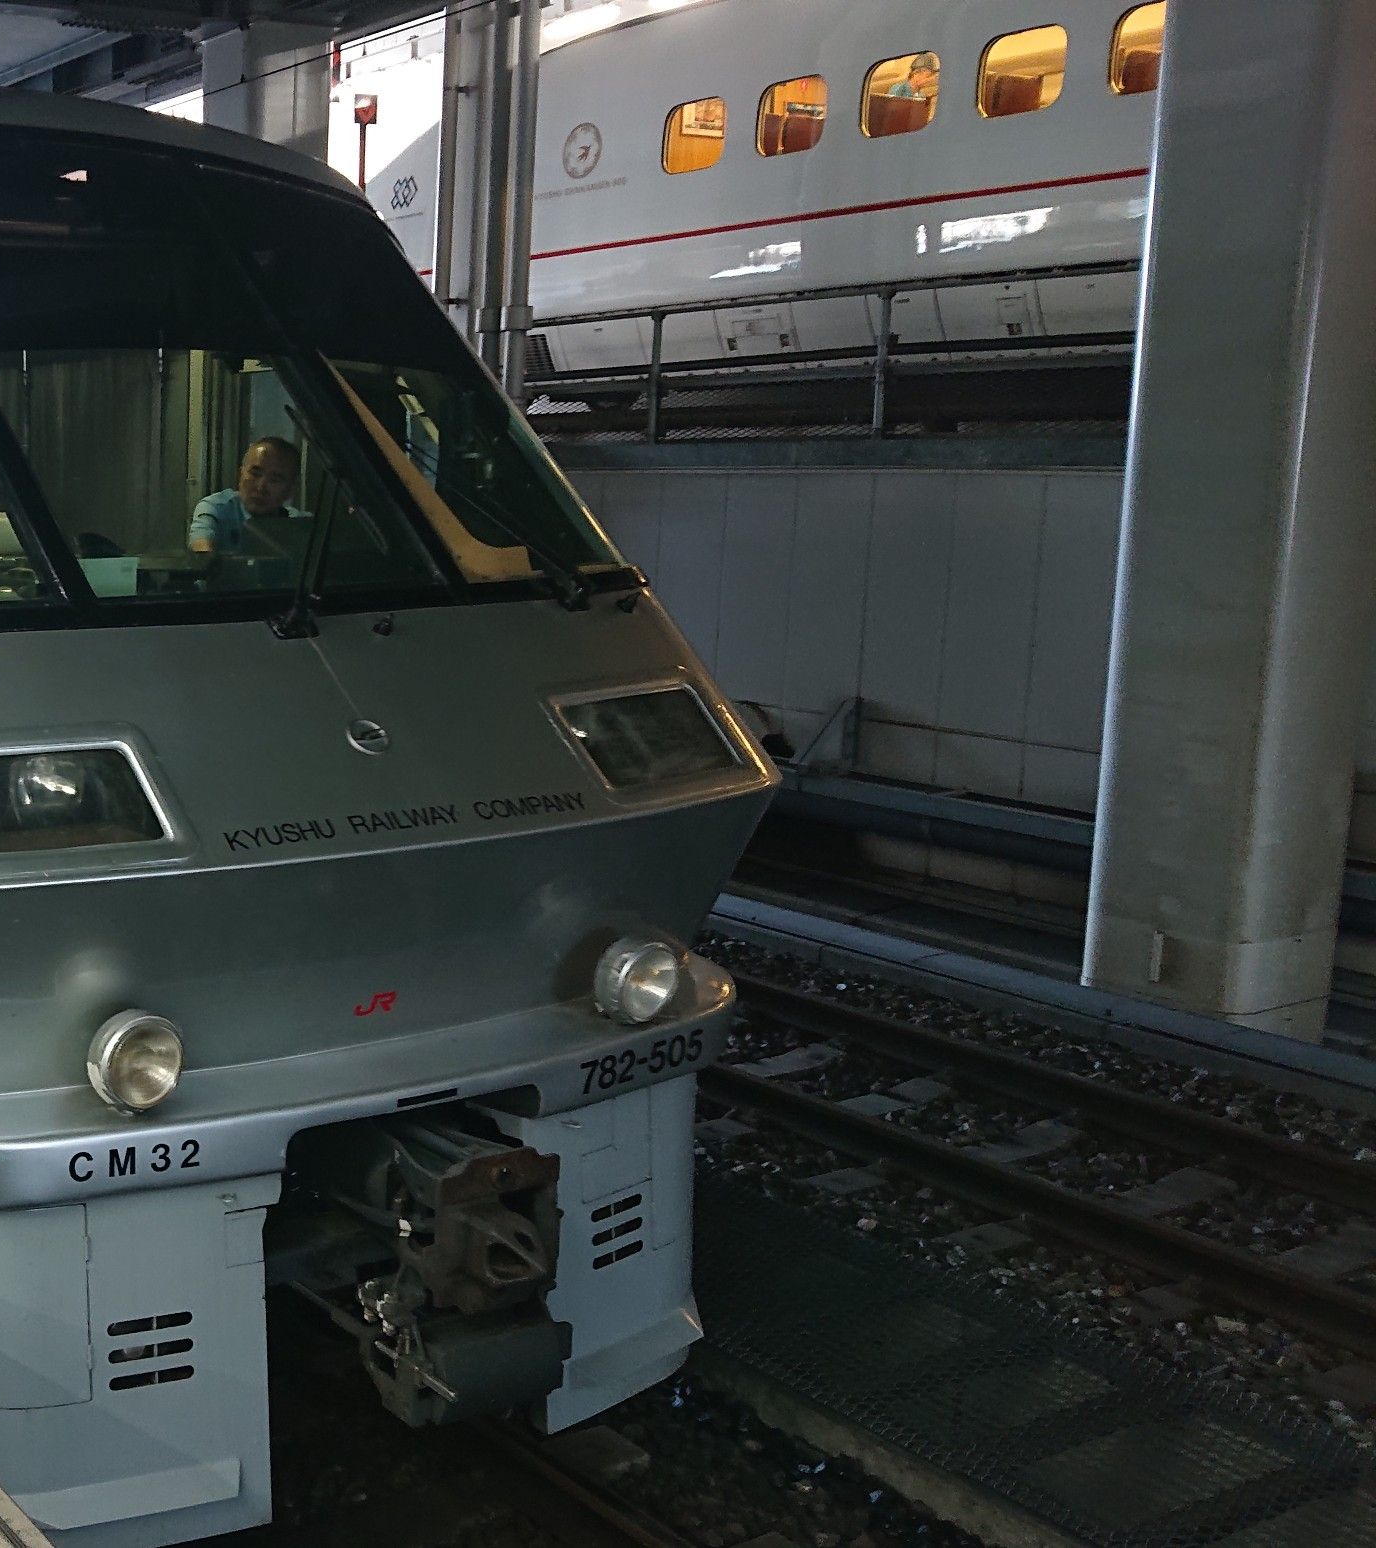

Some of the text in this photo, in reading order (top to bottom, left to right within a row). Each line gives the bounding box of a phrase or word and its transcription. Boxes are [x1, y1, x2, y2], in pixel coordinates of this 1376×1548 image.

[224, 791, 585, 852] KYUSHU RAILWAY COMPANY
[354, 991, 397, 1017] JR
[580, 1028, 704, 1095] 782-505
